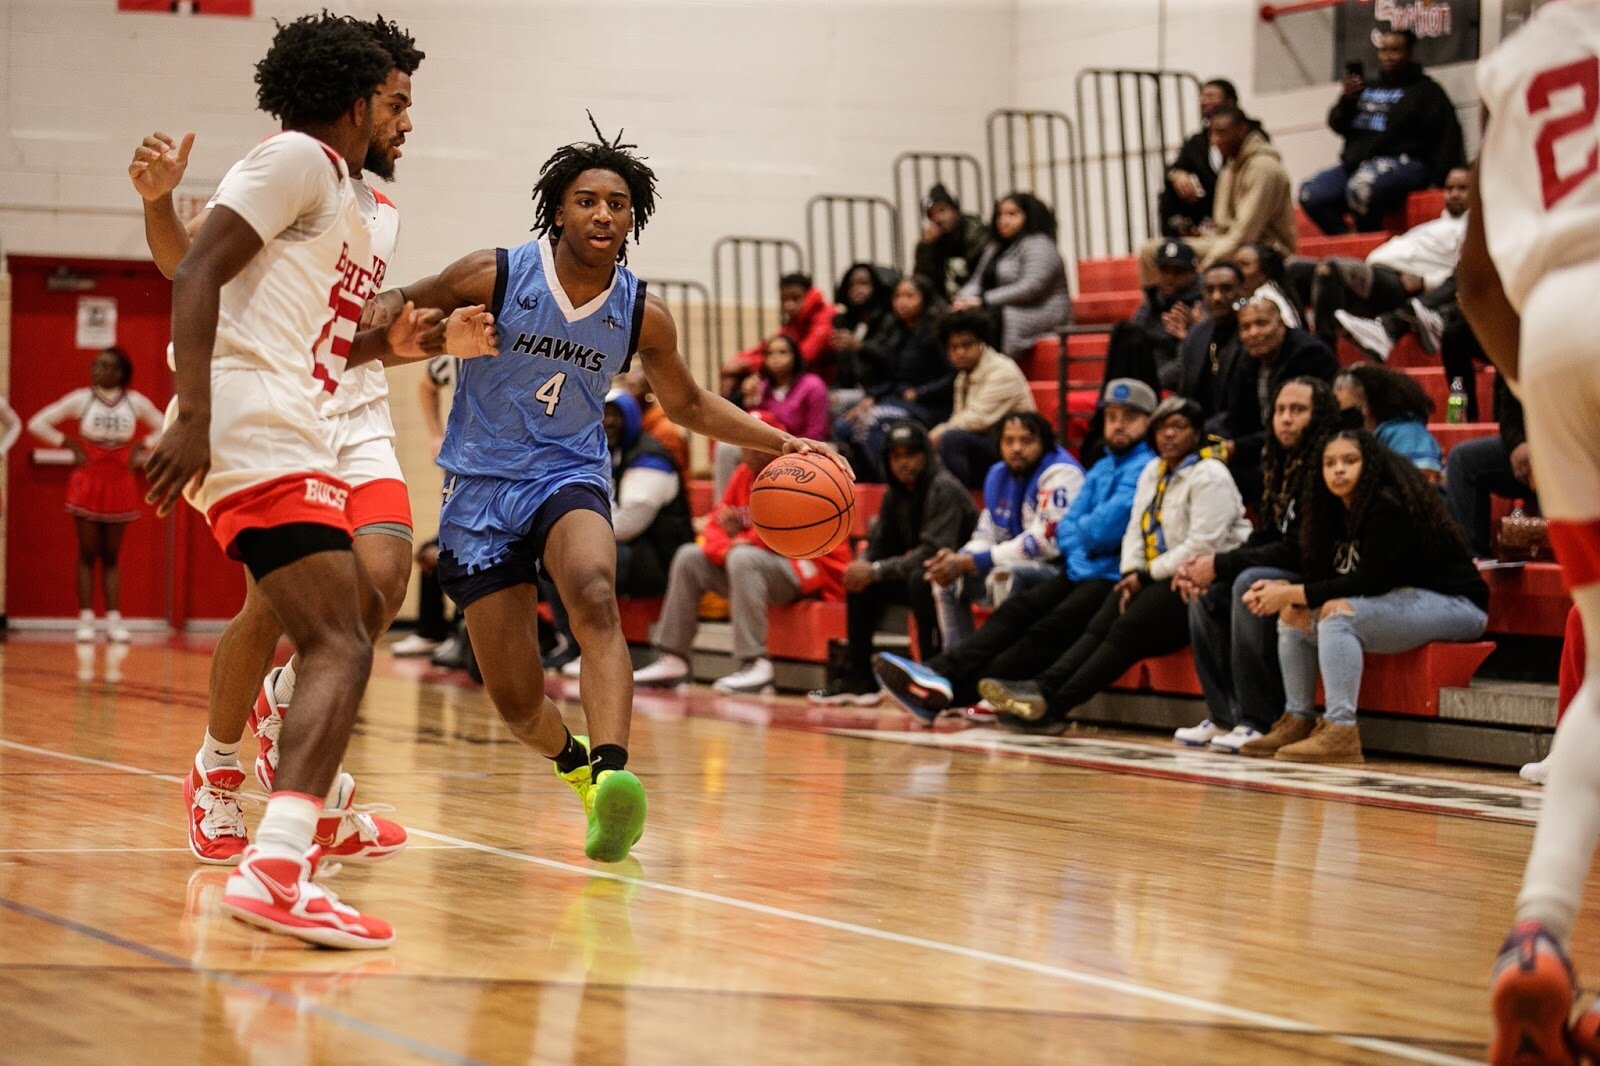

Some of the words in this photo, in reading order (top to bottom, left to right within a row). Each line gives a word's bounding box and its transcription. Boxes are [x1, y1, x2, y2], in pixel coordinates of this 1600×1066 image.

[1526, 54, 1600, 212] 2
[511, 332, 608, 374] HAWKS
[535, 371, 567, 417] 4
[304, 478, 348, 512] BUCS
[1039, 487, 1067, 509] 76
